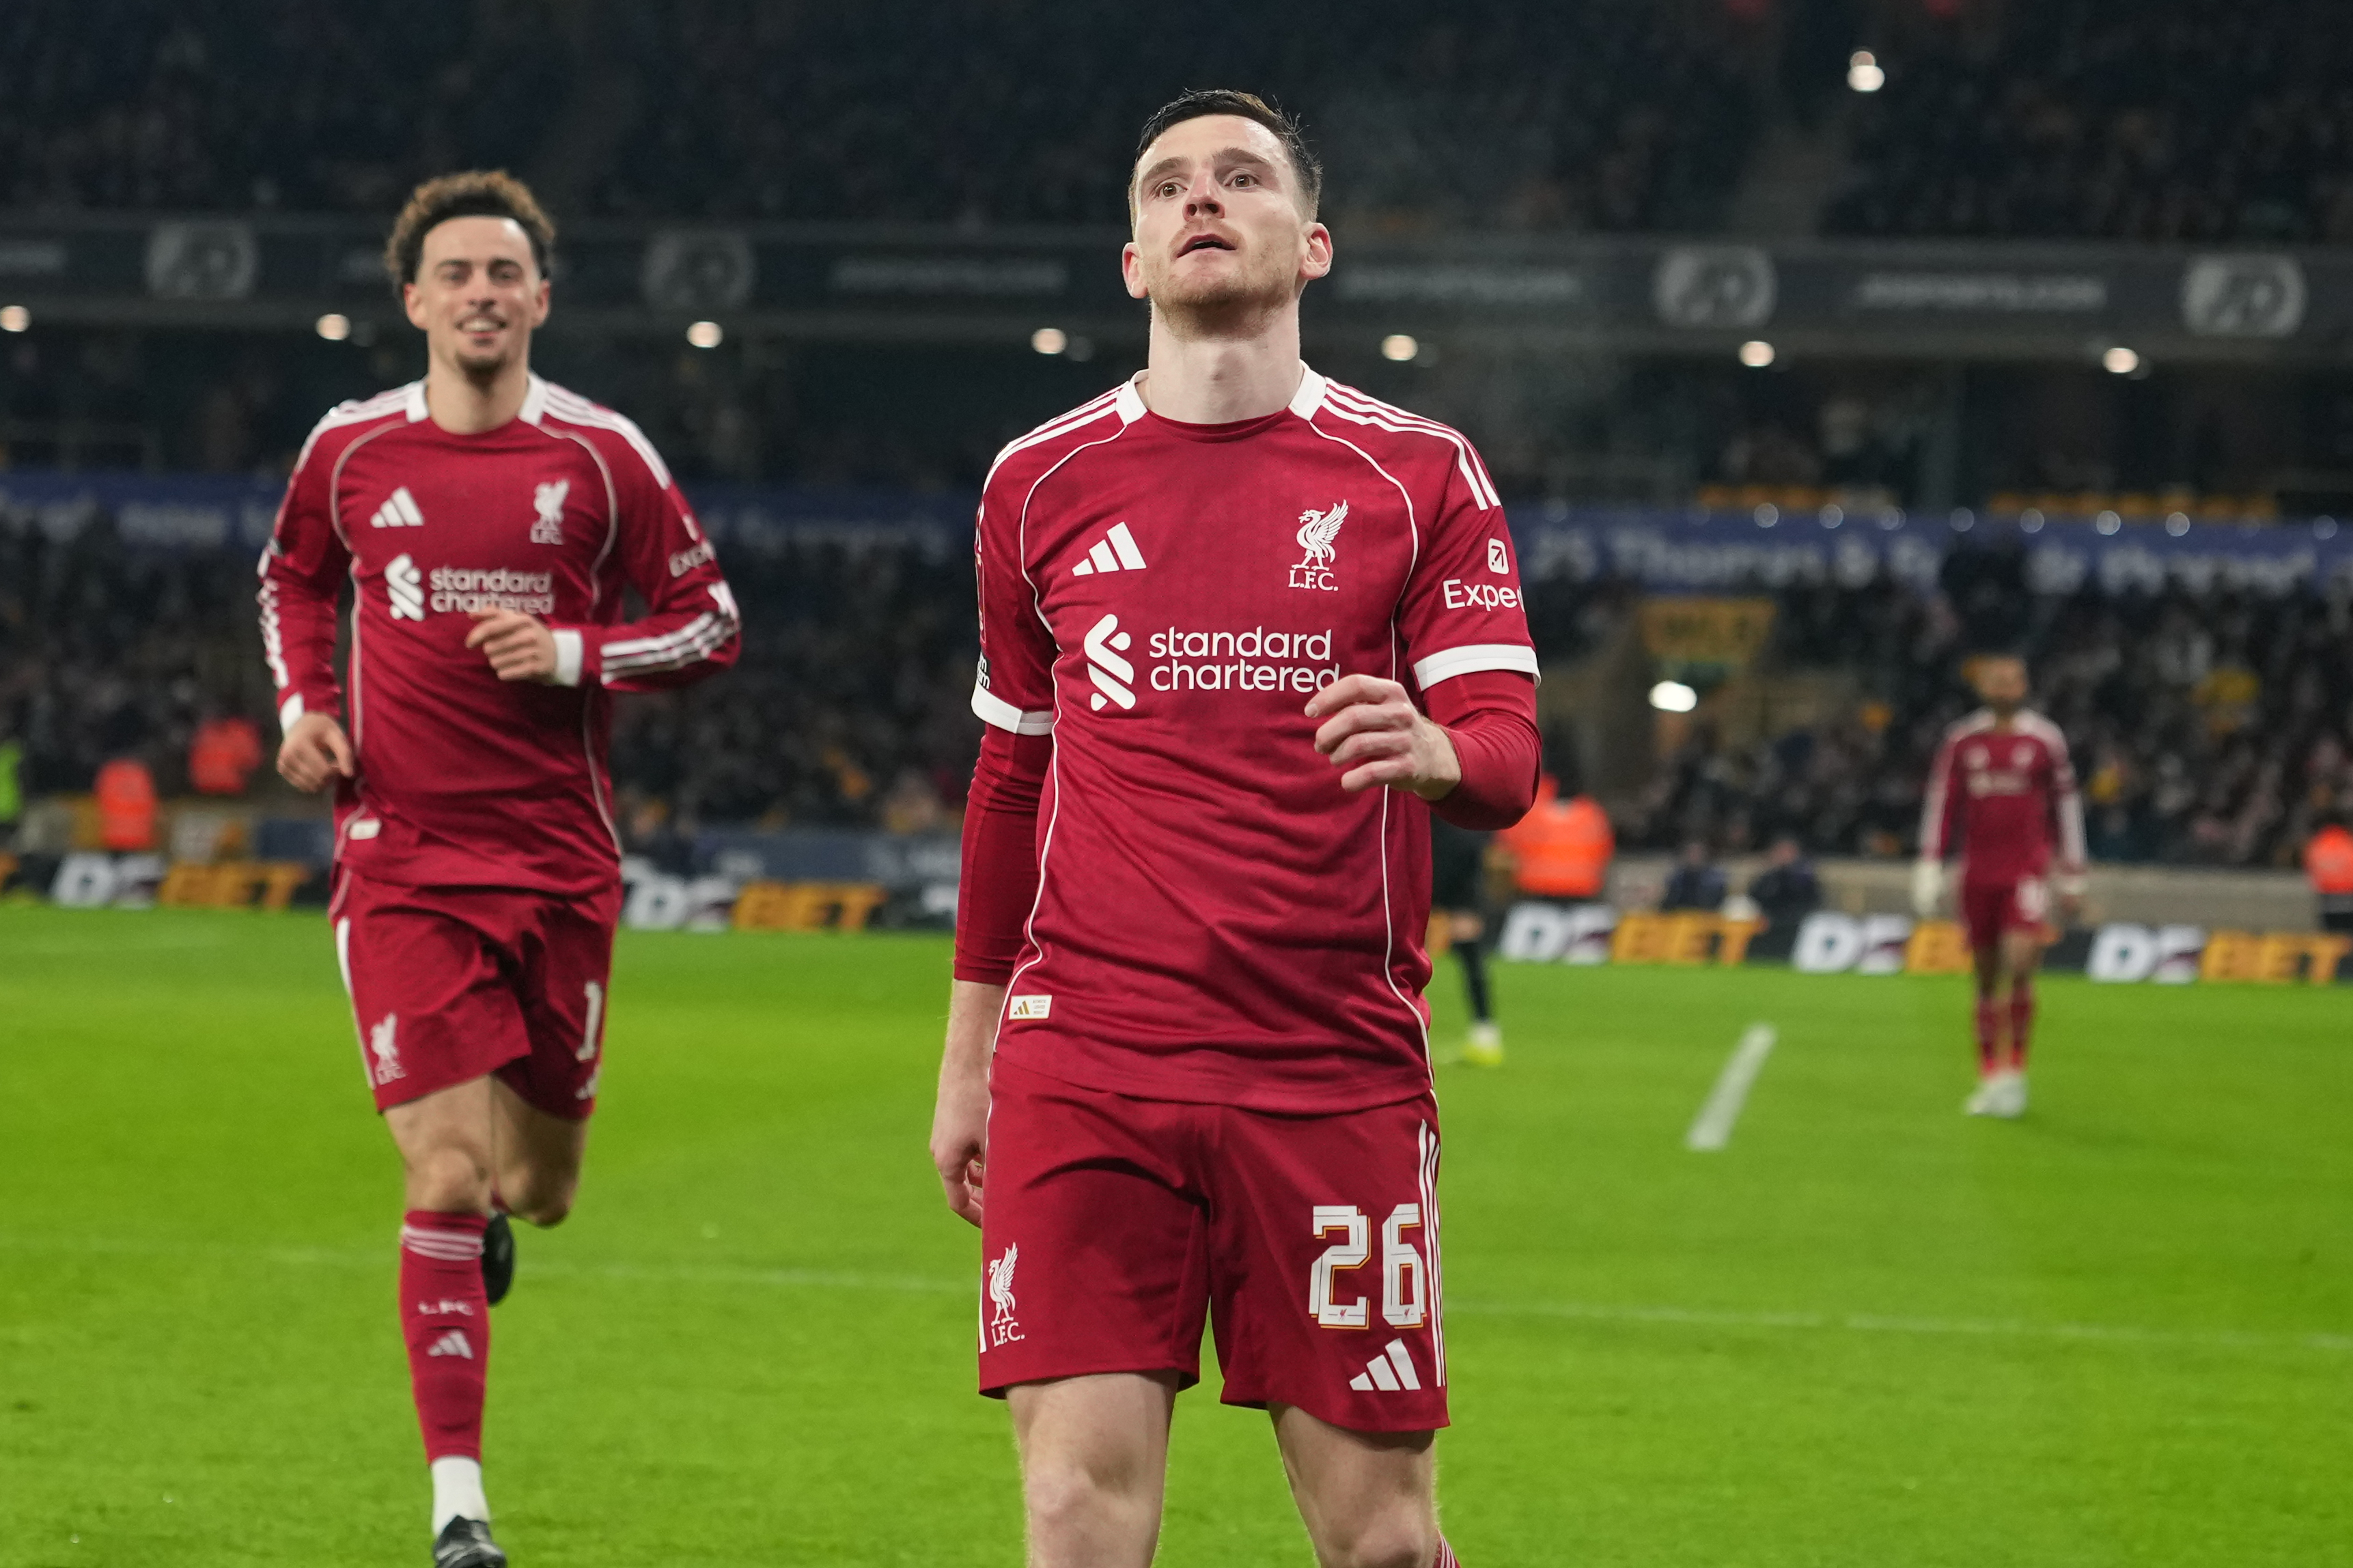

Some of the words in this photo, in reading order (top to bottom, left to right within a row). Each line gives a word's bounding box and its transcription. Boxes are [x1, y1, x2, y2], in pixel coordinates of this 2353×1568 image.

[430, 565, 553, 593] standard
[1288, 570, 1339, 591] L.F.C.
[1149, 625, 1332, 660] standard
[1150, 658, 1341, 693] chartered
[1309, 1203, 1428, 1329] 26
[991, 1322, 1025, 1347] L.F.C.
